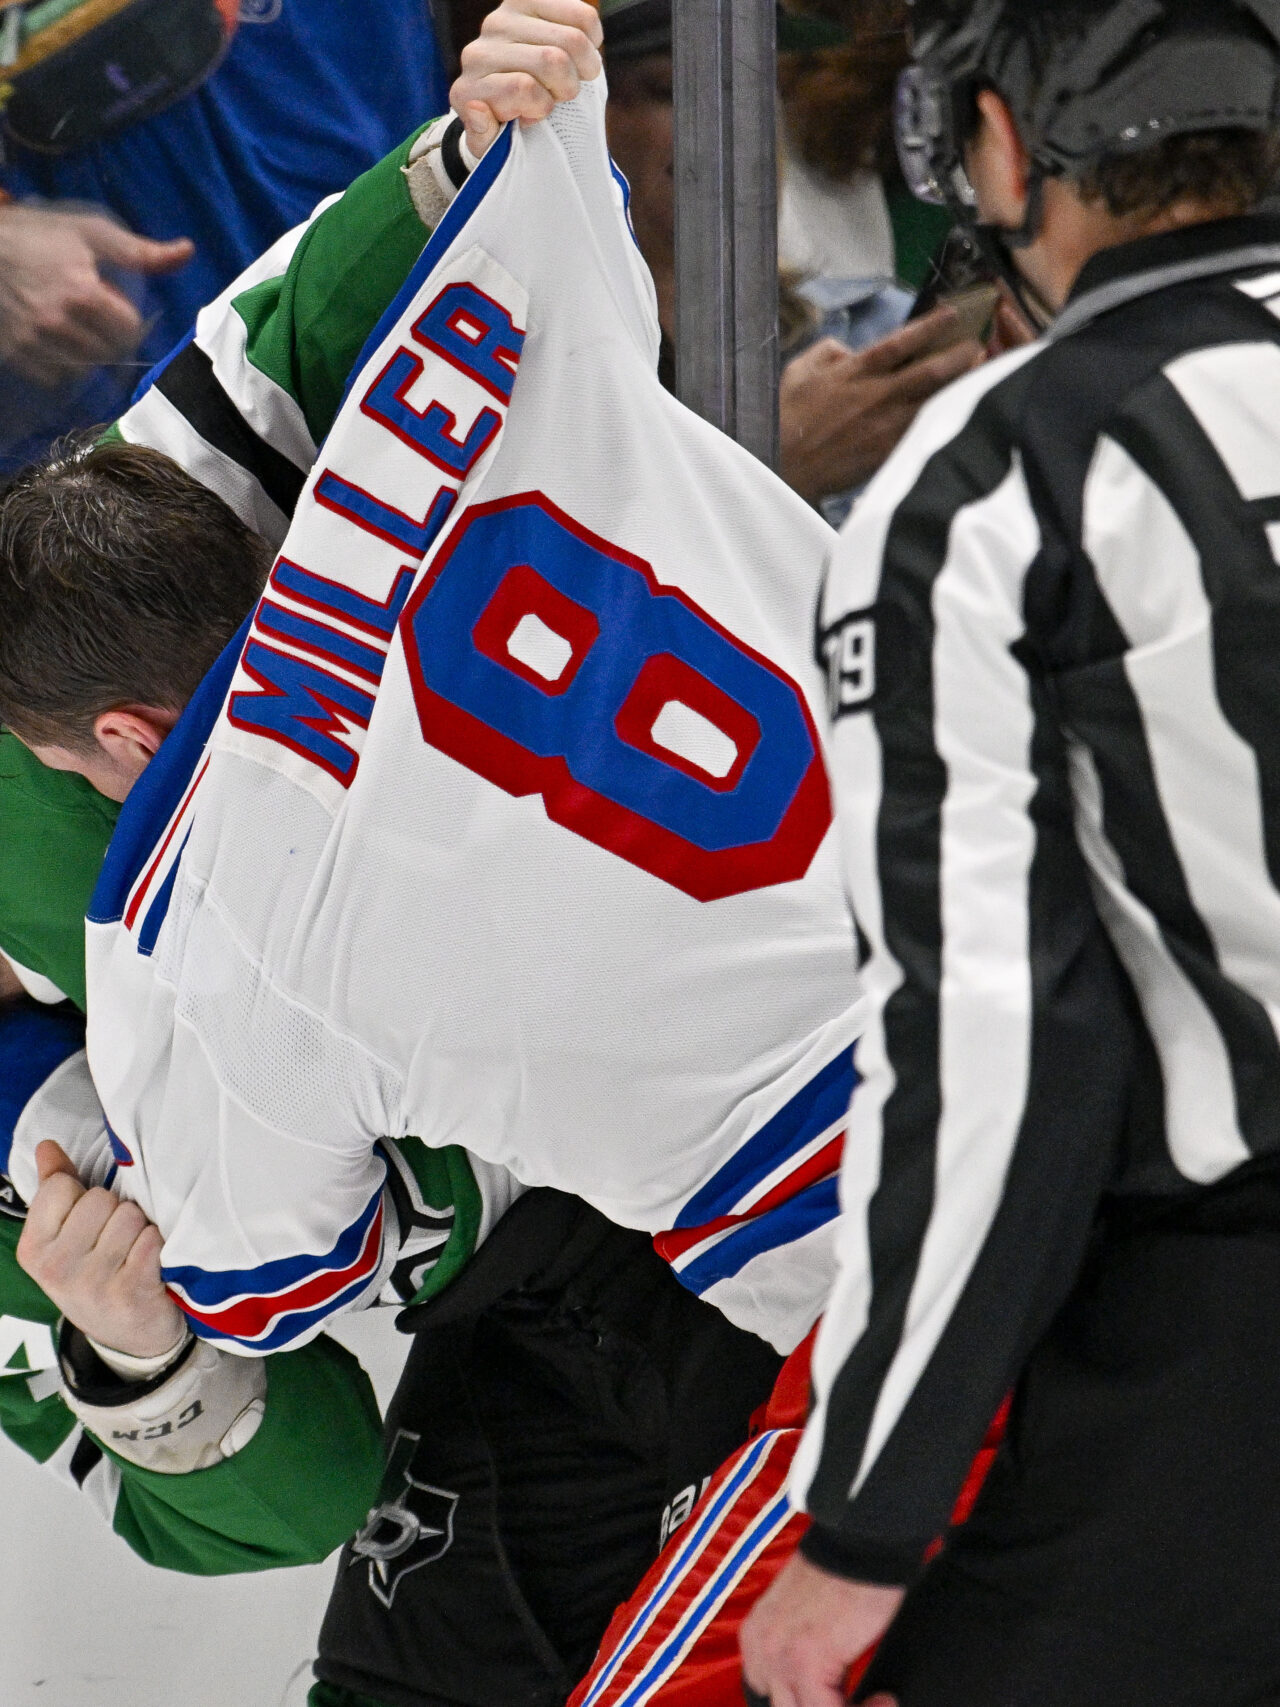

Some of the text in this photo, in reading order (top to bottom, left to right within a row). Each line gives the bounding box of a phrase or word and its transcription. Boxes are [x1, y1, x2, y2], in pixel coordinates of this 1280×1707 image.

[227, 281, 527, 790] MILLER
[398, 489, 833, 903] 8
[112, 1399, 205, 1441] CCM
